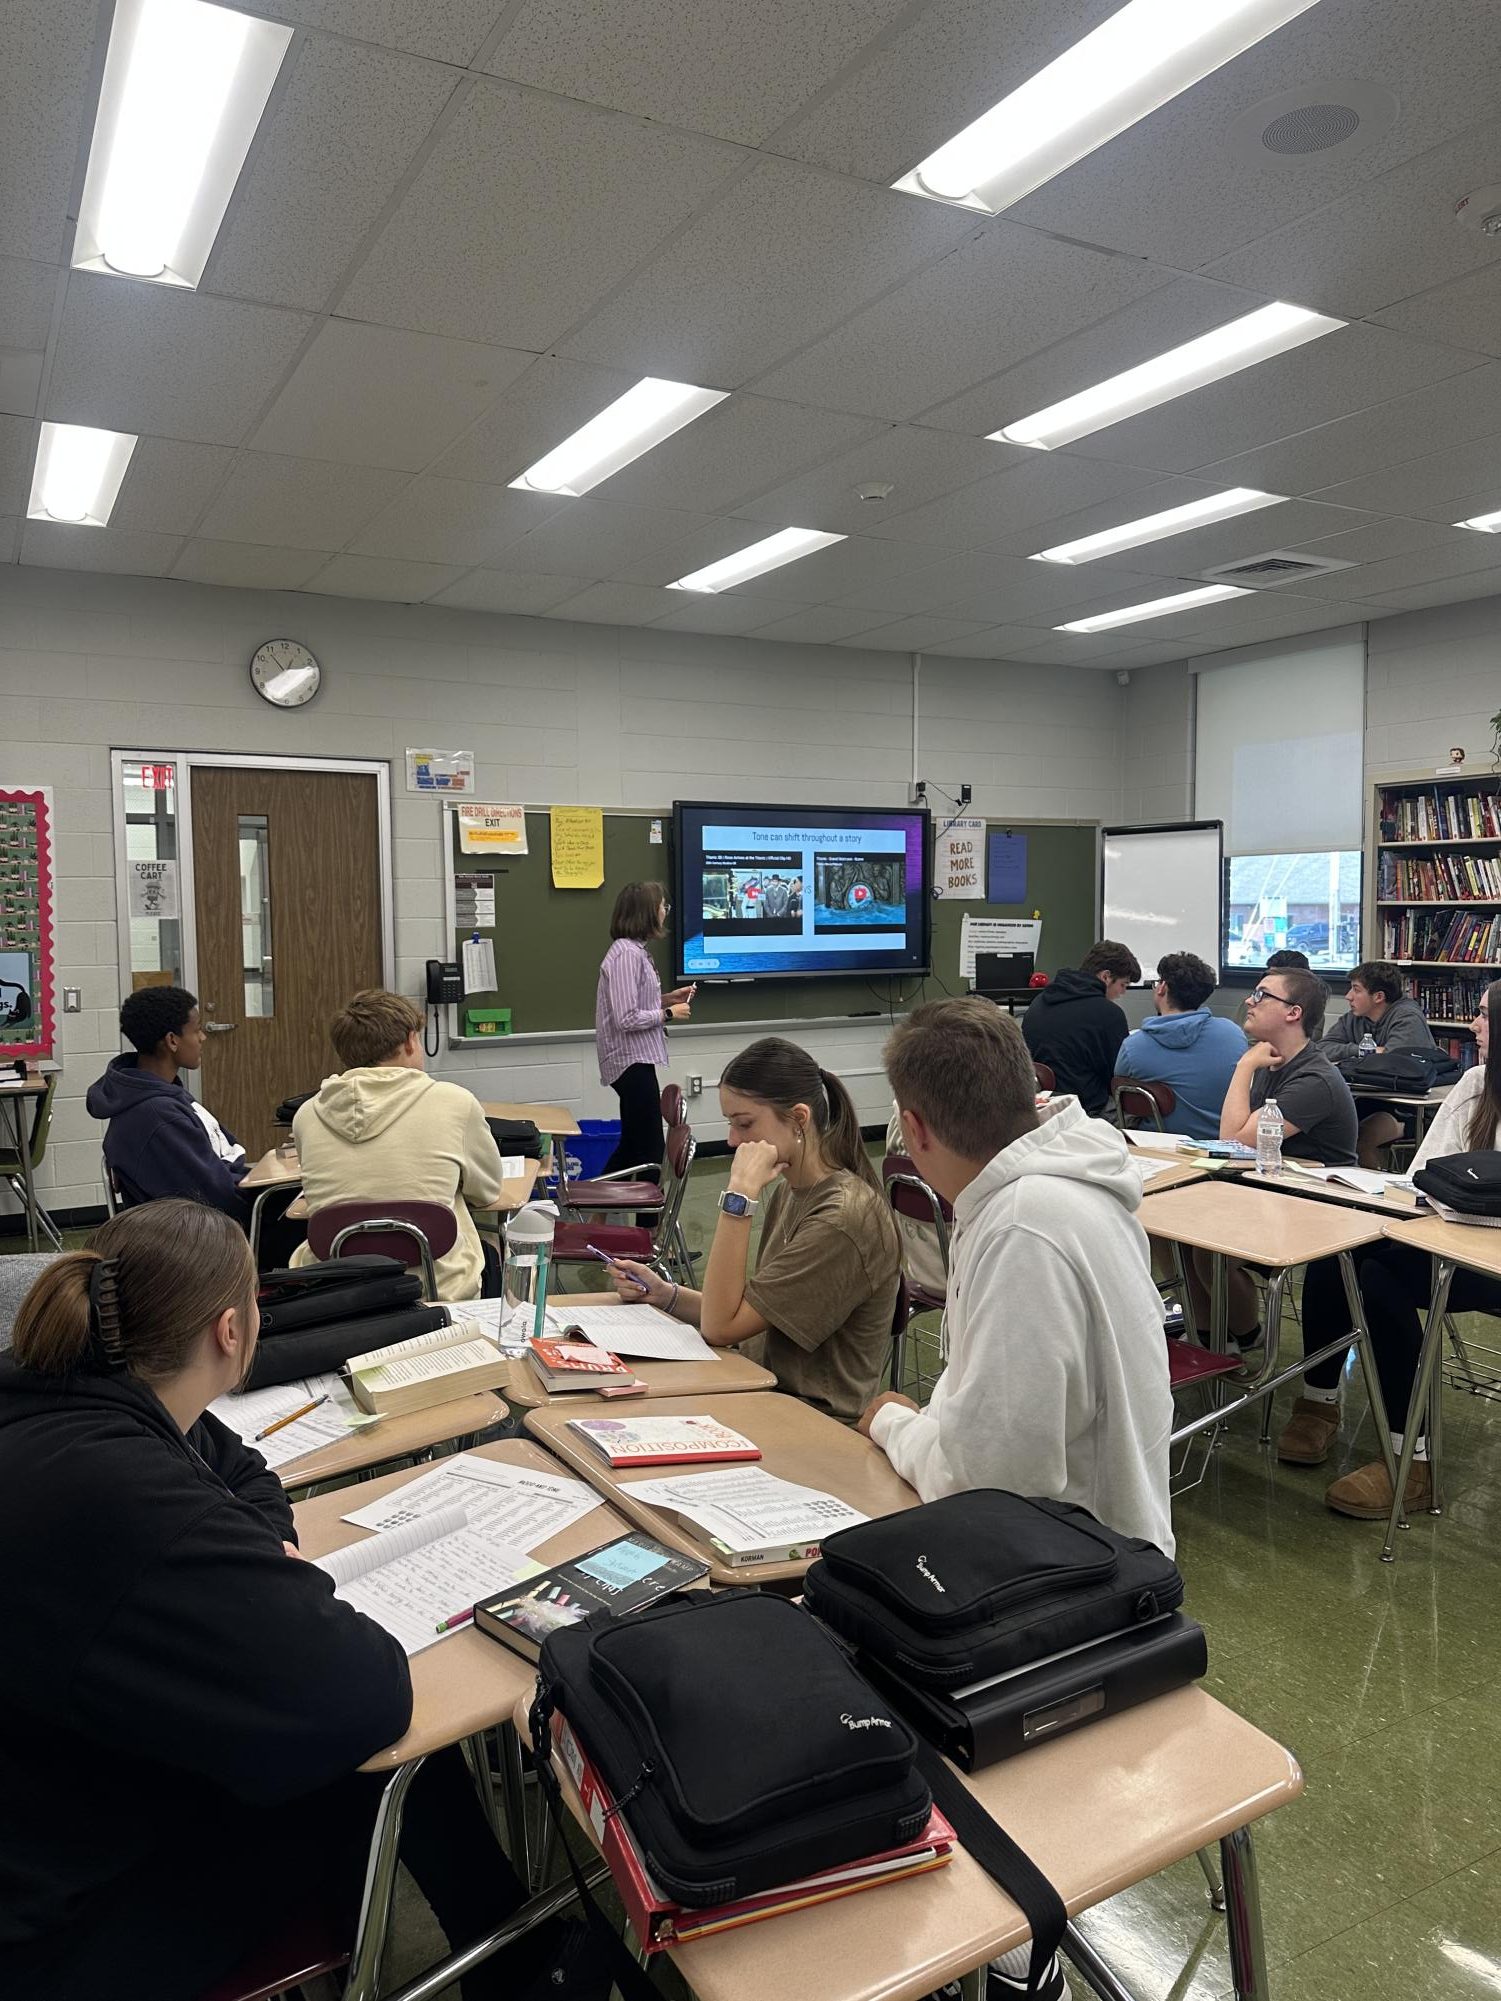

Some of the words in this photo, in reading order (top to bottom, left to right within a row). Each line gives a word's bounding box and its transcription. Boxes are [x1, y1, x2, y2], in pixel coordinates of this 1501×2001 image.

[141, 765, 173, 789] EXIT
[461, 806, 474, 817] FIRE
[474, 806, 490, 817] DRILL
[485, 818, 500, 827] EXIT
[943, 819, 967, 828] LIBRARY
[968, 820, 982, 828] CARD
[752, 831, 769, 841] Tone
[770, 834, 782, 842] can
[784, 833, 800, 842] shift
[801, 833, 838, 844] throughout
[845, 835, 862, 844] story
[950, 842, 973, 856] READ
[135, 863, 167, 872] COFFEE
[950, 857, 975, 872] MORE
[140, 872, 163, 880] CART
[948, 873, 978, 889] BOOKS
[520, 1321, 528, 1343] owala
[613, 1439, 741, 1454] COMPOSITION
[740, 1554, 765, 1563] KORMAN
